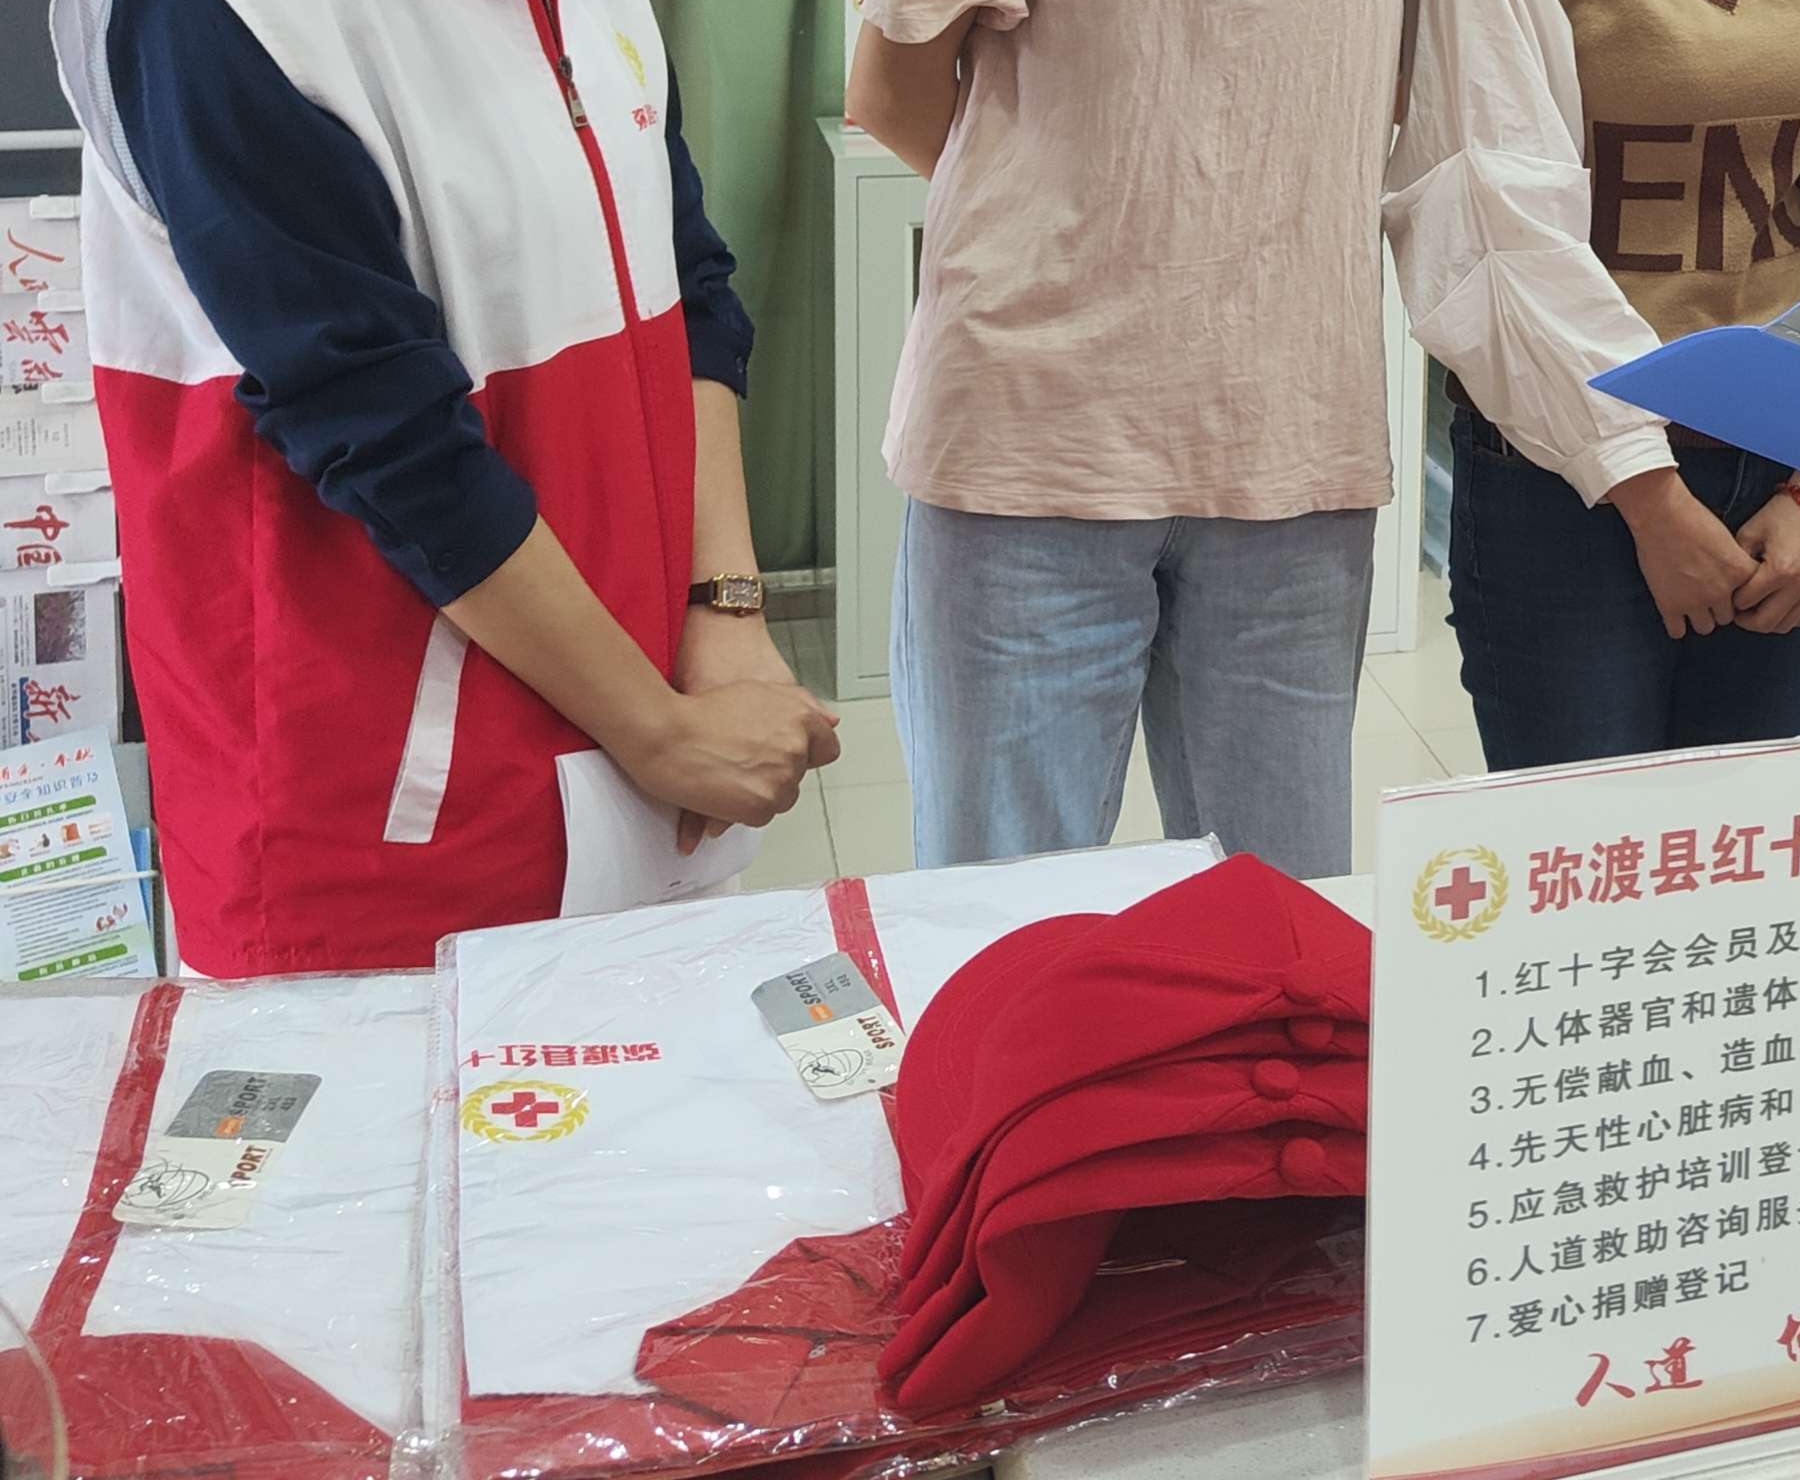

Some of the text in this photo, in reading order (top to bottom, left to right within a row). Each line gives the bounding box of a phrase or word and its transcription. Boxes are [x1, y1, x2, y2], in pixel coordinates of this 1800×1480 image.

[785, 971, 822, 1006] SPORT
[856, 1015, 896, 1050] SPORT
[460, 1041, 662, 1068] 弥渡县红十
[229, 1076, 270, 1116] SPORT
[1465, 1260, 1750, 1343] 7.爱心捐赠登记
[1575, 1336, 1704, 1408] 人道
